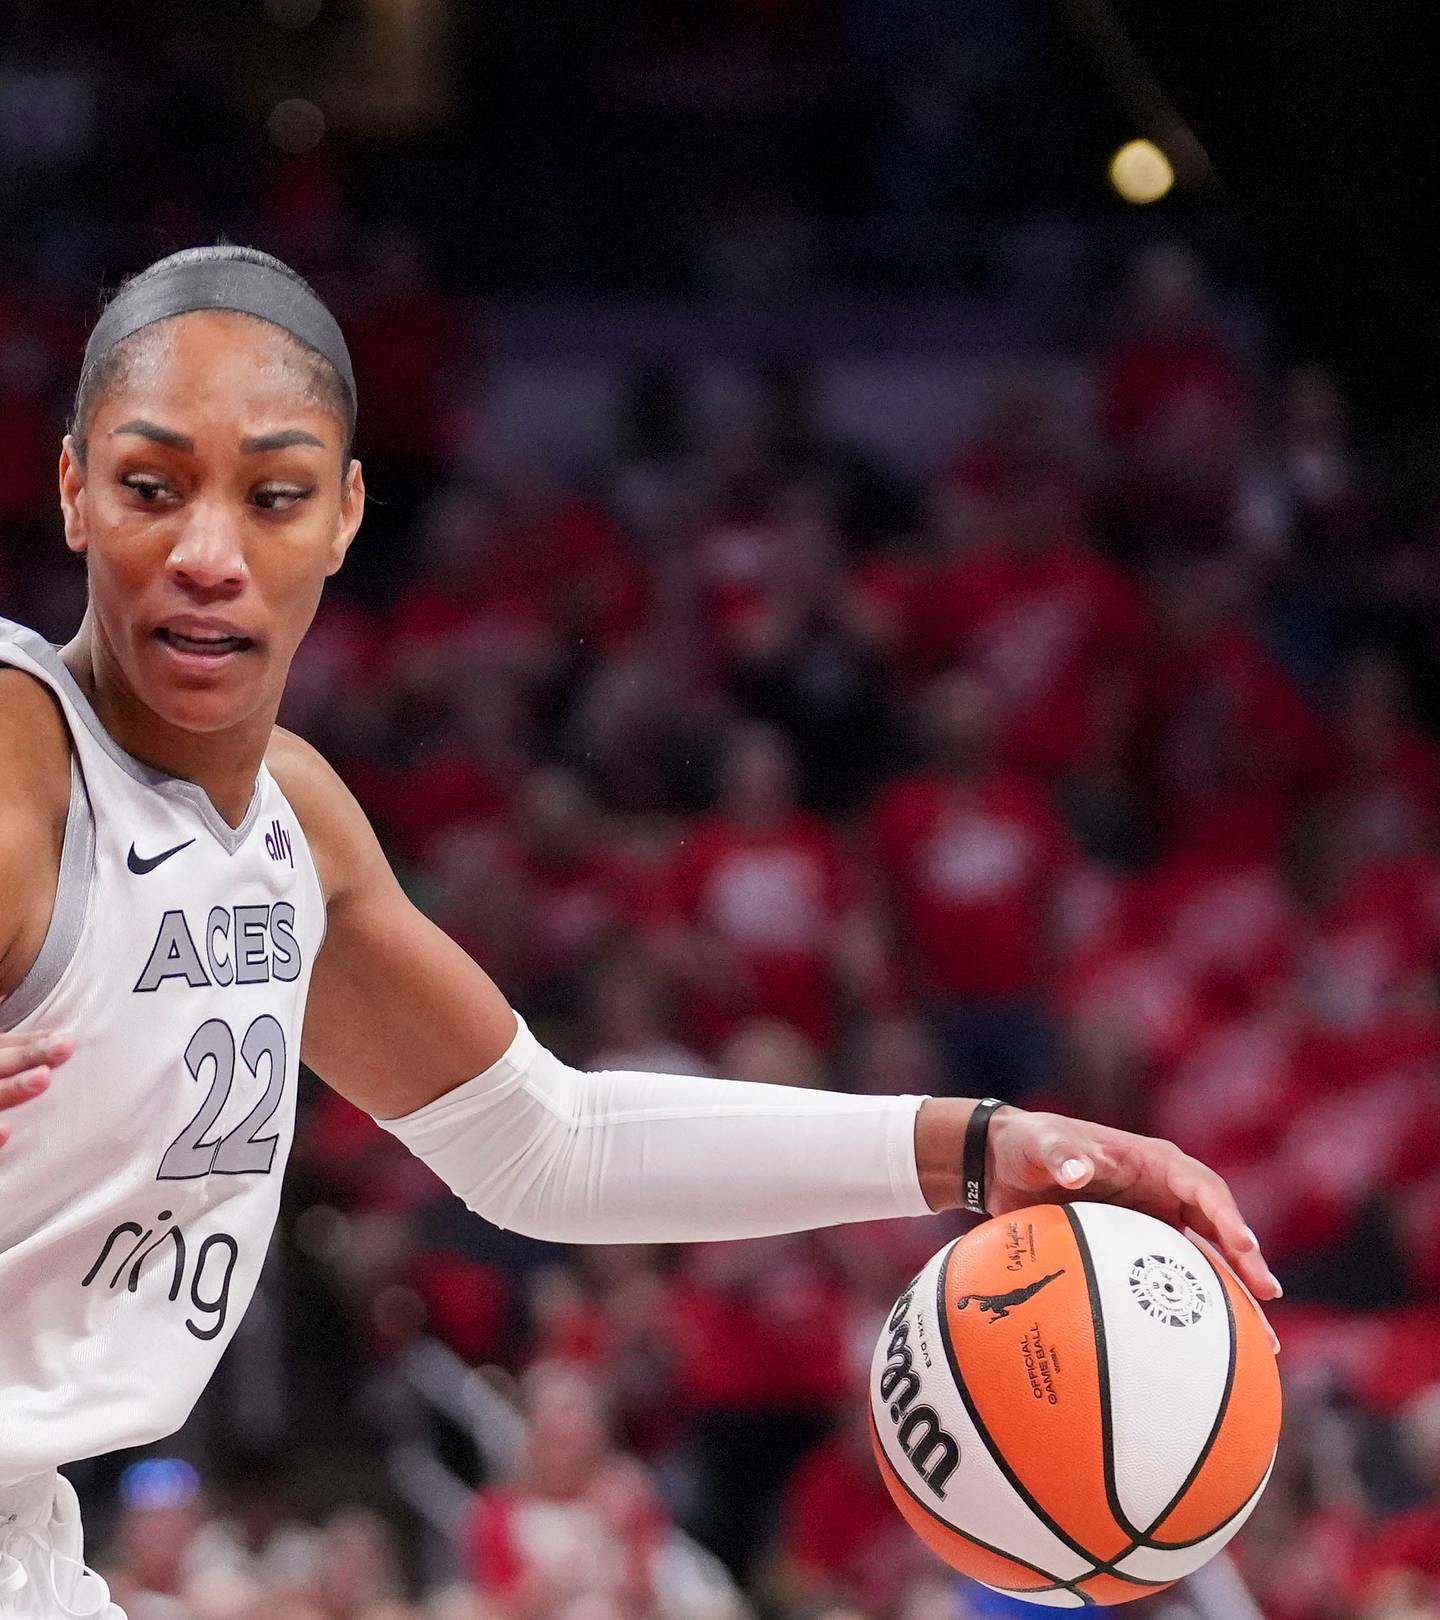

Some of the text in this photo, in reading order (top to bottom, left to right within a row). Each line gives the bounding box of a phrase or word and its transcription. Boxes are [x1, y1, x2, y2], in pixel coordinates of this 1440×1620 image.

[265, 819, 294, 869] ally
[132, 901, 302, 993] ACES
[156, 1013, 287, 1181] 22
[81, 1210, 238, 1341] ring
[920, 1341, 933, 1369] EVO
[1021, 1334, 1042, 1399] OFFICIAL
[1030, 1322, 1058, 1405] GAME BALL
